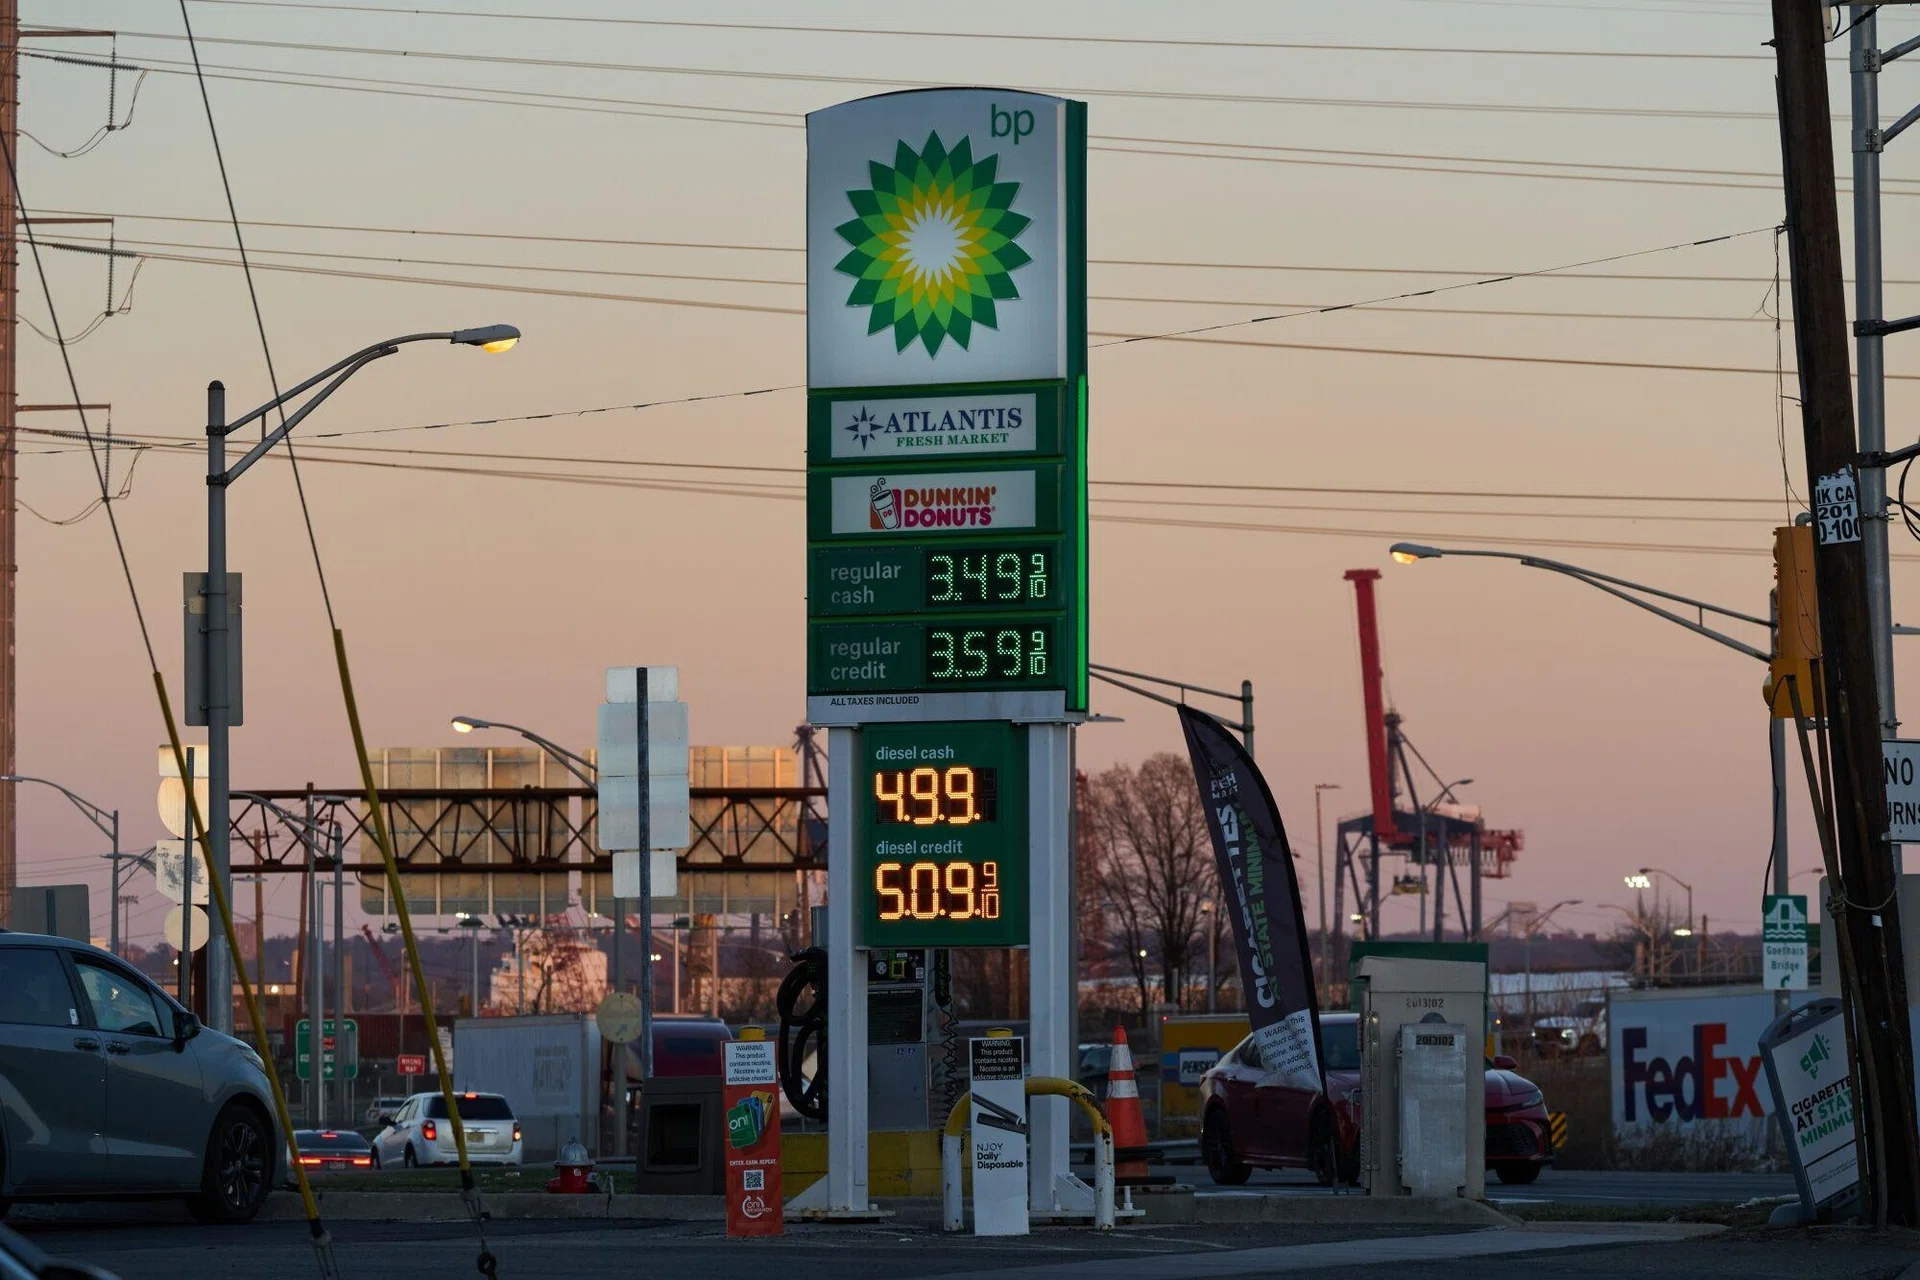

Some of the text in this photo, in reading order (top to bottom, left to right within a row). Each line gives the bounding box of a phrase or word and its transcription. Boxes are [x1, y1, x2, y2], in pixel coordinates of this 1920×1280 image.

[991, 104, 1034, 144] bp
[884, 407, 1023, 434] ATLANTIS
[896, 433, 1009, 448] FRESH MARKET
[903, 486, 997, 508] DUNKIN'
[903, 507, 993, 528] DONUTS
[1818, 503, 1852, 520] 201
[830, 561, 901, 585] regular
[931, 553, 1021, 601] 3.49
[830, 585, 875, 604] cash
[830, 637, 901, 660] regular
[931, 630, 1021, 678] 3.59
[830, 661, 886, 681] credit
[830, 696, 919, 706] ALL TAXES INCLUDED
[876, 745, 954, 760] diesel cash
[1884, 757, 1913, 786] NO
[876, 840, 963, 855] diesel credit
[1251, 900, 1274, 969] STATE
[1771, 960, 1800, 972] Bridge
[1416, 1035, 1454, 1046] 2013102
[747, 1052, 766, 1060] product
[1622, 1023, 1765, 1123] FedEx
[1791, 1075, 1851, 1116] CIGARETTE
[1797, 1088, 1852, 1133] AT STAT
[1800, 1108, 1854, 1148] MINIMU
[977, 1142, 1004, 1151] NJOY
[977, 1151, 999, 1161] Daily
[977, 1160, 1024, 1170] Disposable
